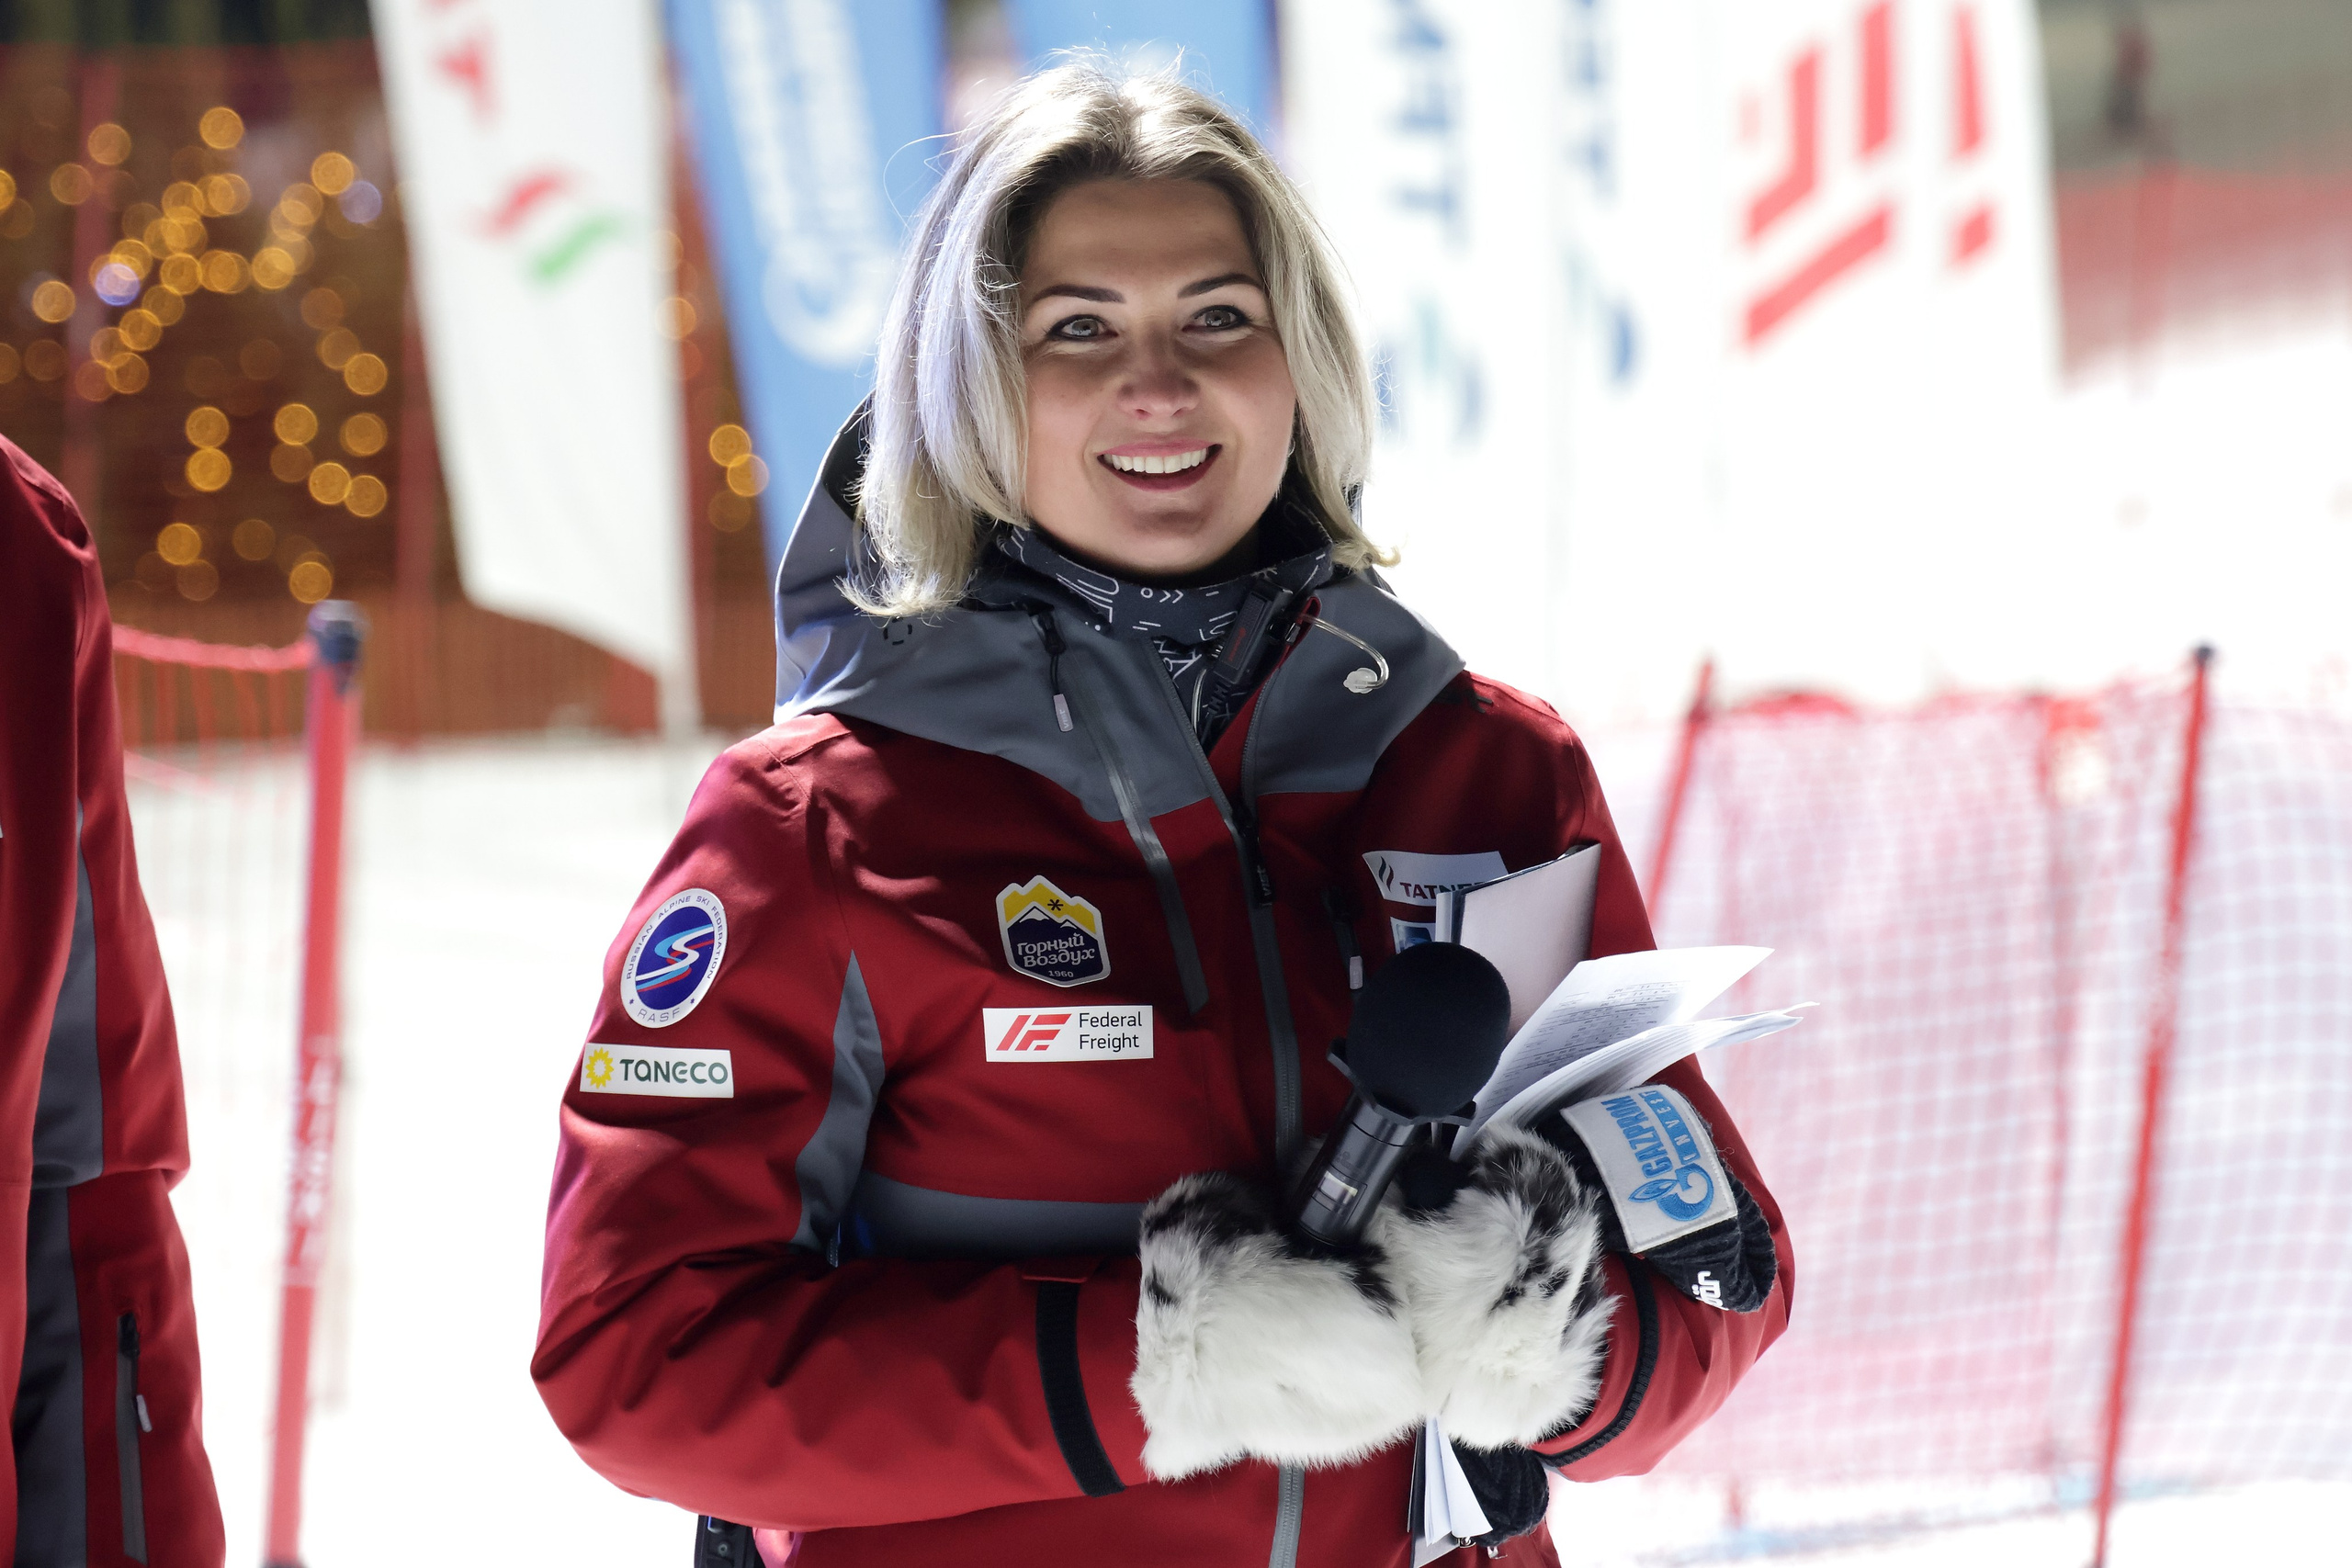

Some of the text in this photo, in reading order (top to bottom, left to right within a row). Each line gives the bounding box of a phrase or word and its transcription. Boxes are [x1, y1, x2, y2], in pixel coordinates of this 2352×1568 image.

[1399, 881, 1485, 900] TATN
[626, 896, 724, 980] RUSSIAN ALPINE SKI FEDERATION
[637, 1008, 681, 1023] RASF
[1079, 1010, 1142, 1028] Federal
[1079, 1033, 1140, 1053] Freight
[619, 1058, 729, 1085] TANECO
[1600, 1095, 1673, 1179] GAZPROM
[1641, 1089, 1699, 1163] INVEST
